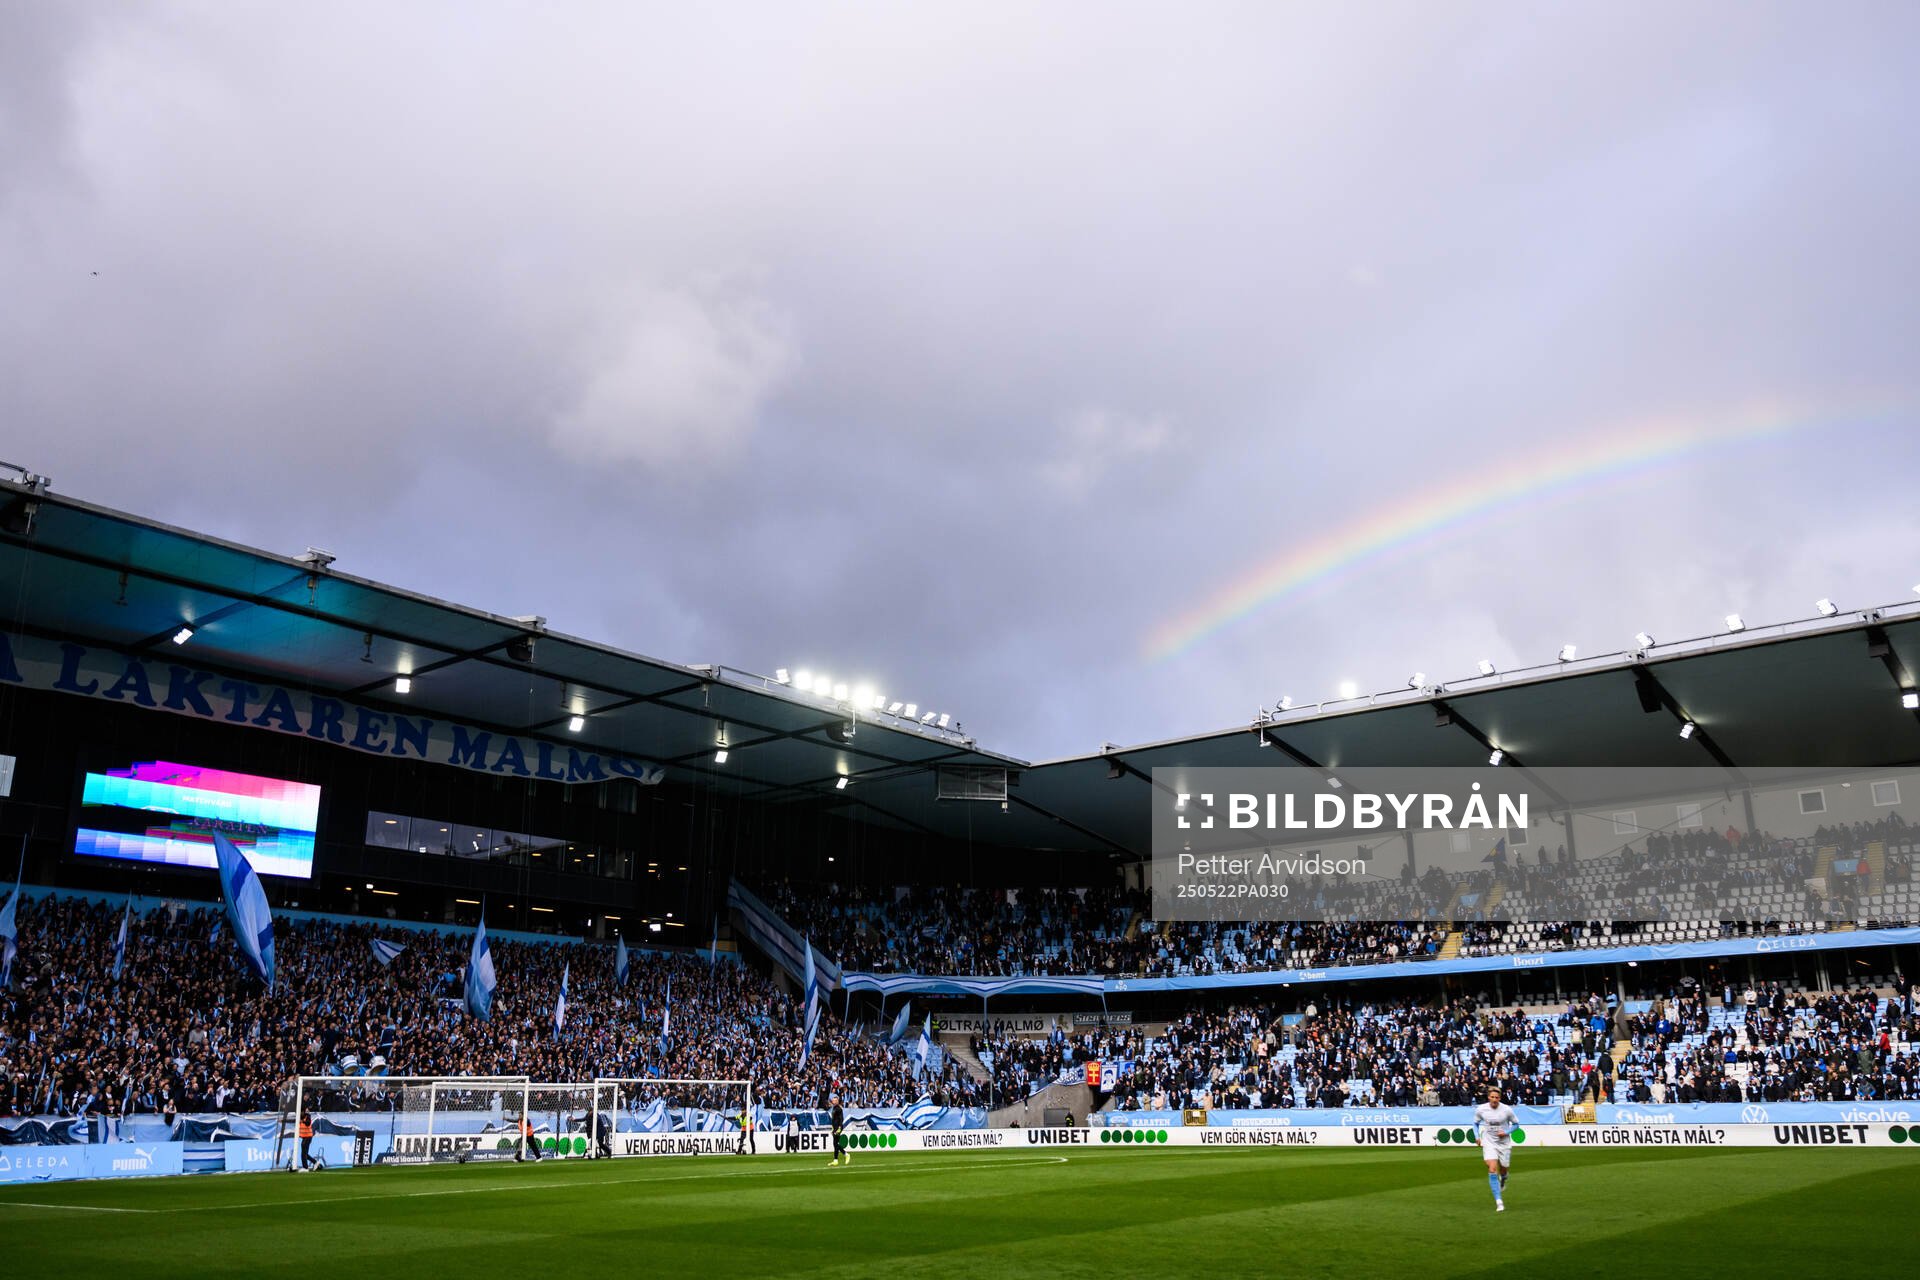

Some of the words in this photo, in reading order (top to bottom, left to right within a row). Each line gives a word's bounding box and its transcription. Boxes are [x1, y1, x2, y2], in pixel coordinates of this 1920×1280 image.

[1771, 938, 1817, 949] ELEDA
[1354, 1112, 1410, 1123] exakta
[1841, 1108, 1910, 1122] visolve
[922, 1135, 941, 1148] VEM
[942, 1132, 956, 1147] GÖR
[958, 1131, 980, 1147] NÄSTA
[981, 1130, 1003, 1146] MÅL?
[1028, 1129, 1090, 1144] UNIBET
[1200, 1131, 1223, 1144] VEM
[1225, 1128, 1247, 1144] GÖR
[1250, 1128, 1283, 1144] NÄSTA
[1286, 1127, 1317, 1144] MÅL?
[1353, 1128, 1423, 1144] UNIBET
[1568, 1129, 1598, 1144] VEM
[1602, 1126, 1630, 1144] GÖR
[1634, 1126, 1681, 1144] NÄSTA
[1685, 1125, 1725, 1144] MÅL?
[1774, 1125, 1869, 1145] UNIBET
[625, 1139, 649, 1154] VEM
[653, 1135, 674, 1153] GÖR
[678, 1134, 713, 1153] NÄSTA
[16, 1156, 69, 1169] ELEDA
[112, 1158, 147, 1171] PUMA
